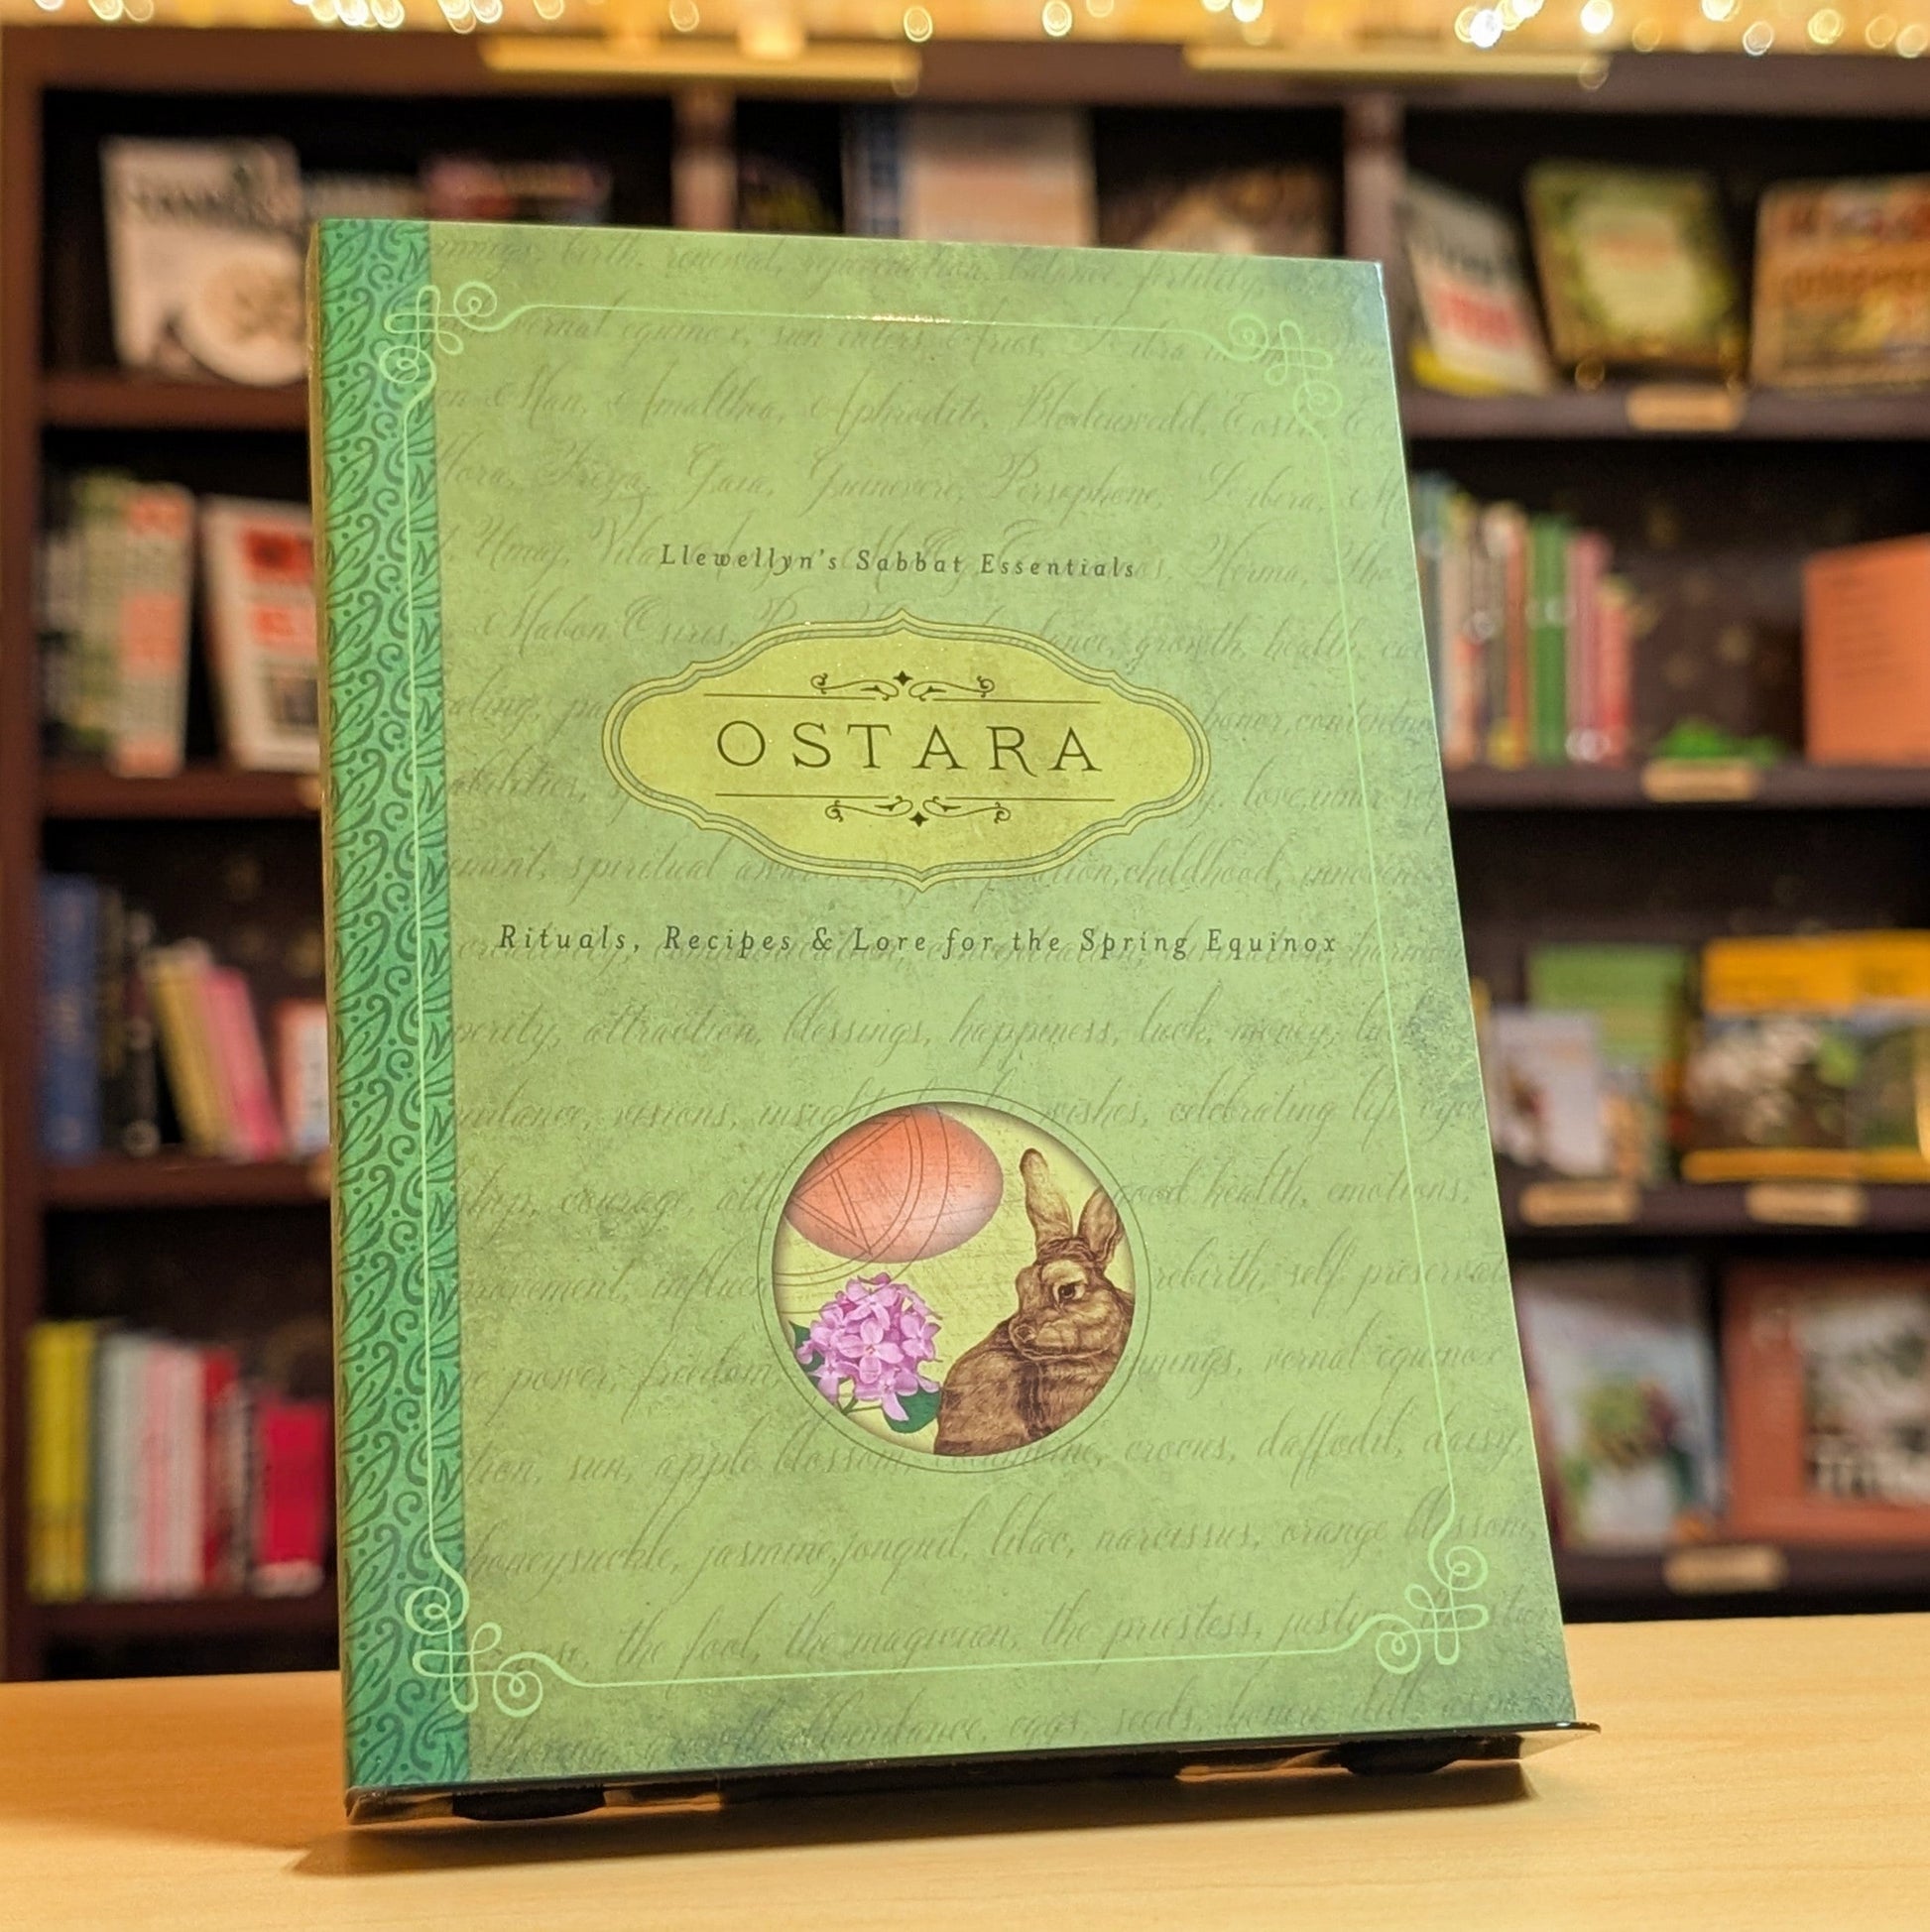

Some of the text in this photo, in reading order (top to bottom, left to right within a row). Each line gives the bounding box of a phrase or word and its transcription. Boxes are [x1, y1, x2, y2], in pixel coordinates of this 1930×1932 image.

[661, 543, 1134, 578] Llewellyn's Sabbat Essentials
[717, 720, 1103, 779] OSTARA
[498, 924, 640, 953] Rituals,
[664, 925, 790, 960] Recipes
[812, 927, 833, 952] &
[853, 927, 926, 952] Lore
[942, 927, 994, 961] for
[1014, 928, 1060, 952] the
[1081, 928, 1188, 961] Spring
[1207, 928, 1336, 961] Equinox
[784, 986, 934, 1069] blessings,
[948, 992, 1121, 1071] happiness,
